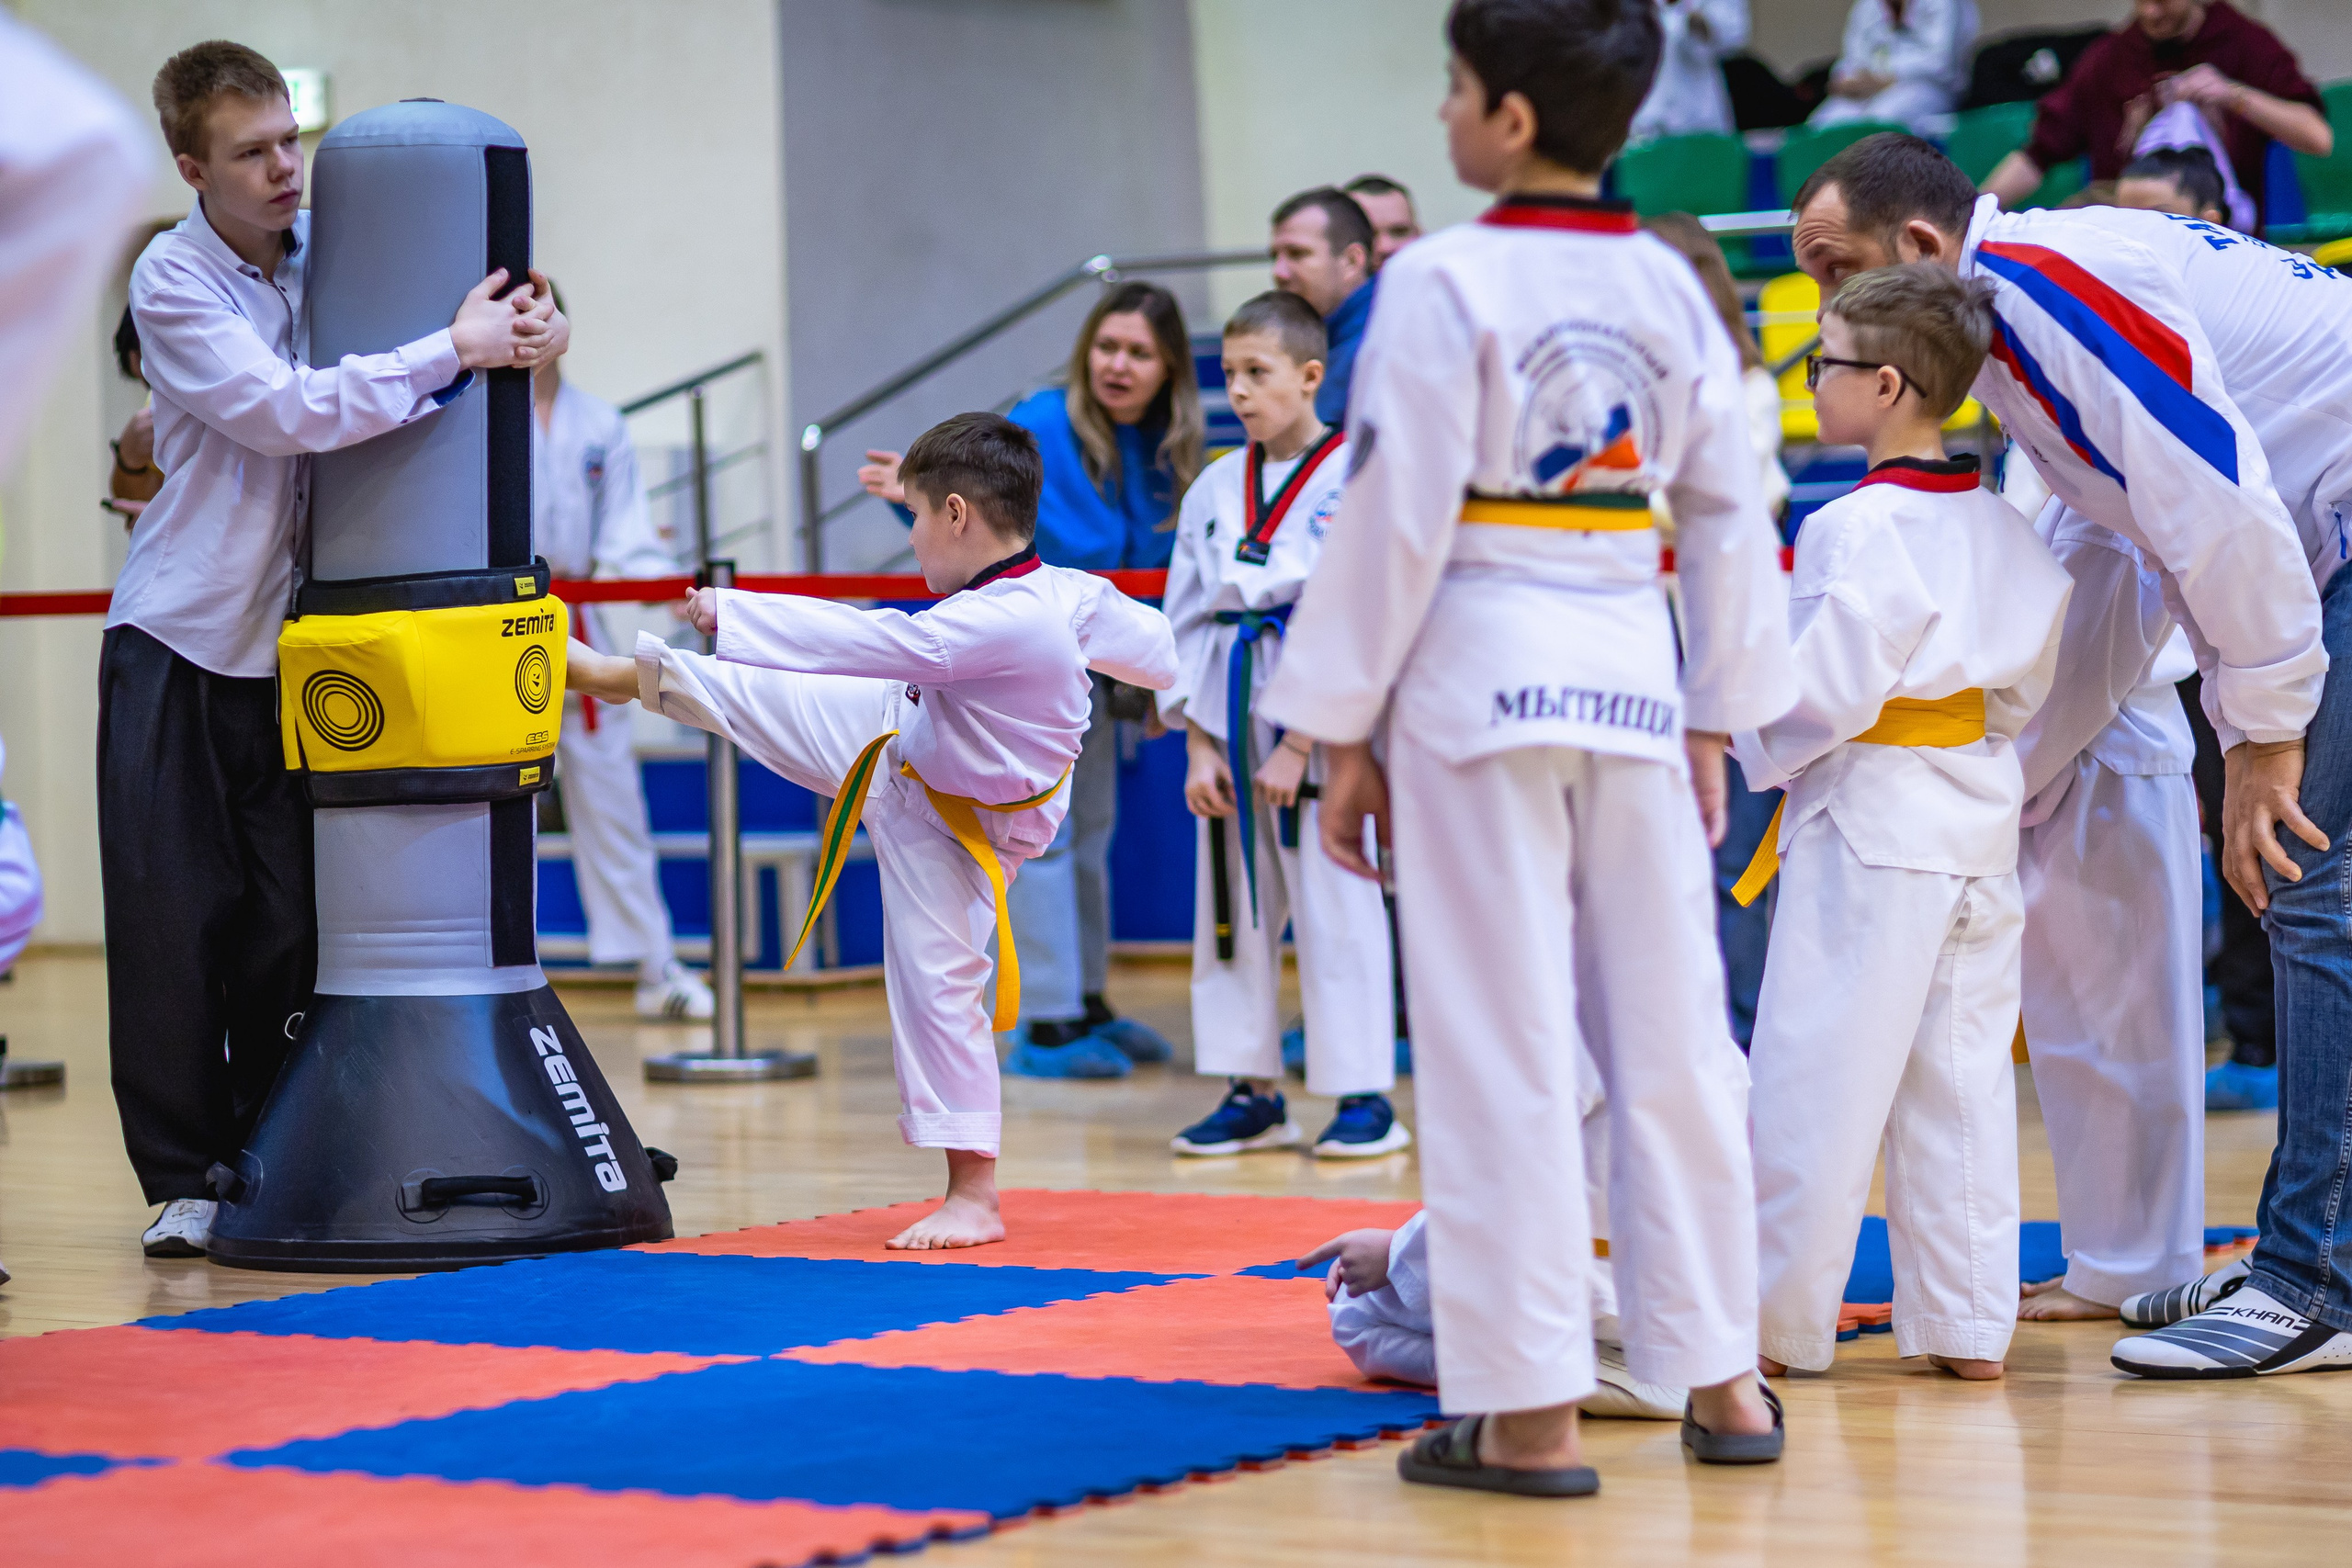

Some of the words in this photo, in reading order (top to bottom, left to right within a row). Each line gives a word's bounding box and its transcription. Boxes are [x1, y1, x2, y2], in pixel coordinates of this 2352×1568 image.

[1490, 683, 1675, 739] МЫТИЩИ
[526, 730, 549, 745] ESS
[2231, 1307, 2296, 1328] KHAN
